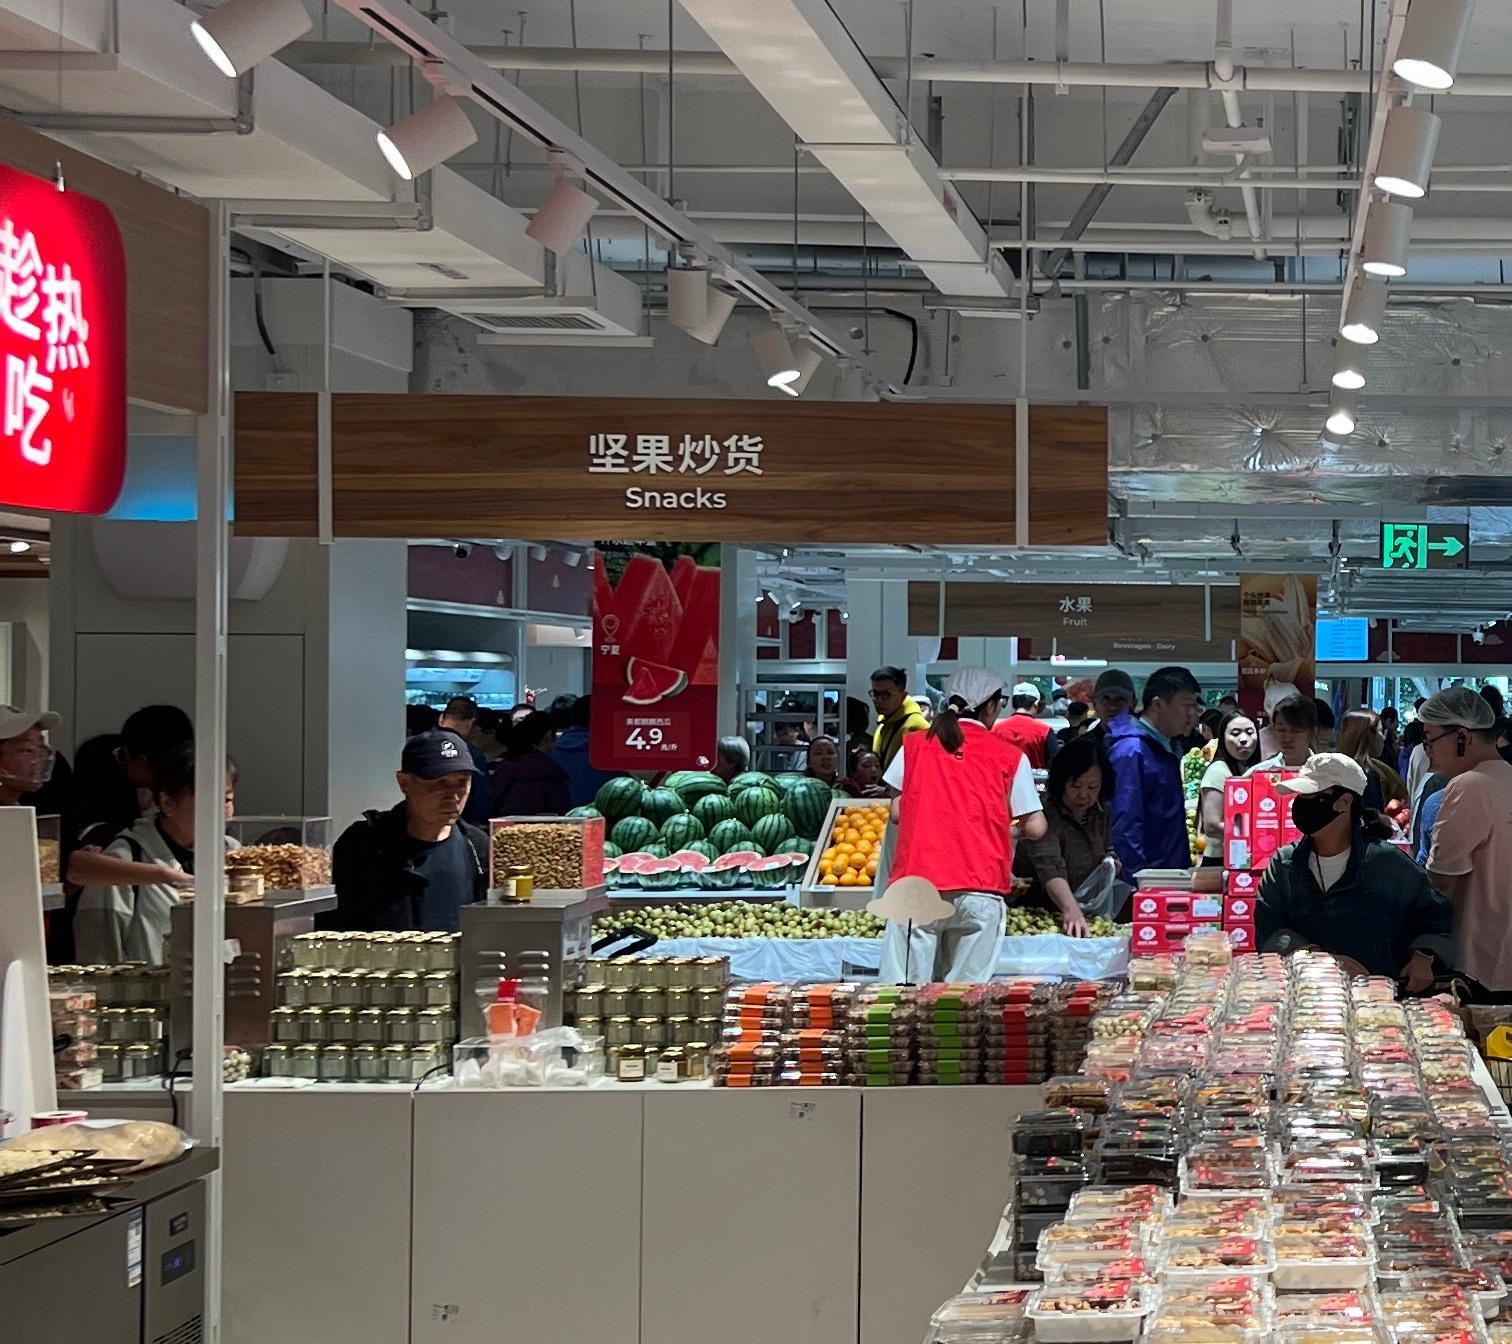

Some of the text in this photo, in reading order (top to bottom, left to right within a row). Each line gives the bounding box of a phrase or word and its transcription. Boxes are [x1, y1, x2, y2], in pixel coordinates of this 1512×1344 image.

[4, 353, 53, 466] 吃
[588, 433, 765, 476] 坚果炒货
[625, 487, 728, 509] Snacks
[1059, 596, 1093, 613] 水果
[1063, 617, 1088, 626] Fruit
[625, 727, 663, 750] 4.9
